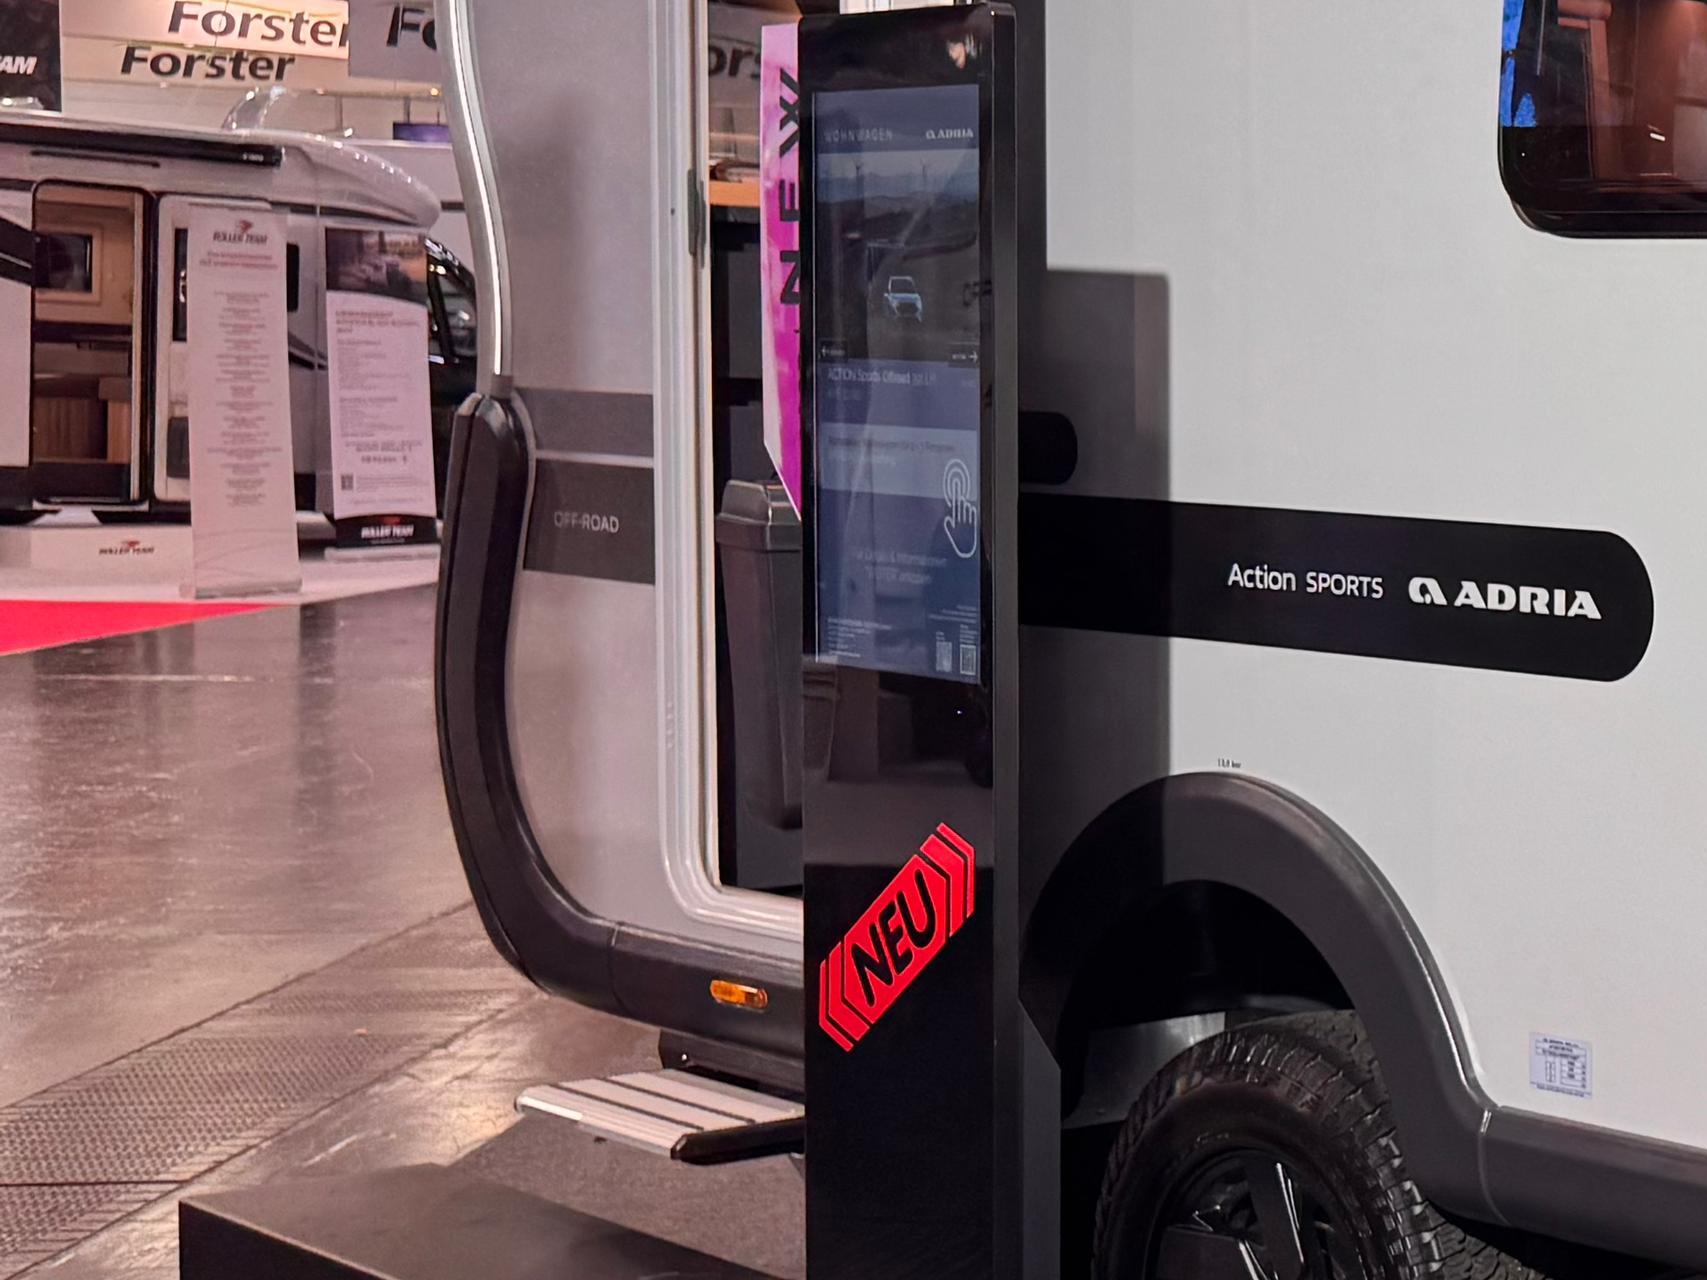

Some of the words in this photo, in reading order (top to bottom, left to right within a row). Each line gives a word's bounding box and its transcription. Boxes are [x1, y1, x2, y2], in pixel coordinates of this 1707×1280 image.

[0, 56, 37, 75] AM
[120, 46, 296, 82] Forster
[553, 510, 620, 534] OFF-ROAD
[1226, 561, 1297, 593] Action
[1305, 571, 1384, 600] SPORTS
[1453, 579, 1603, 621] ADRIA
[850, 868, 937, 1008] NEU
